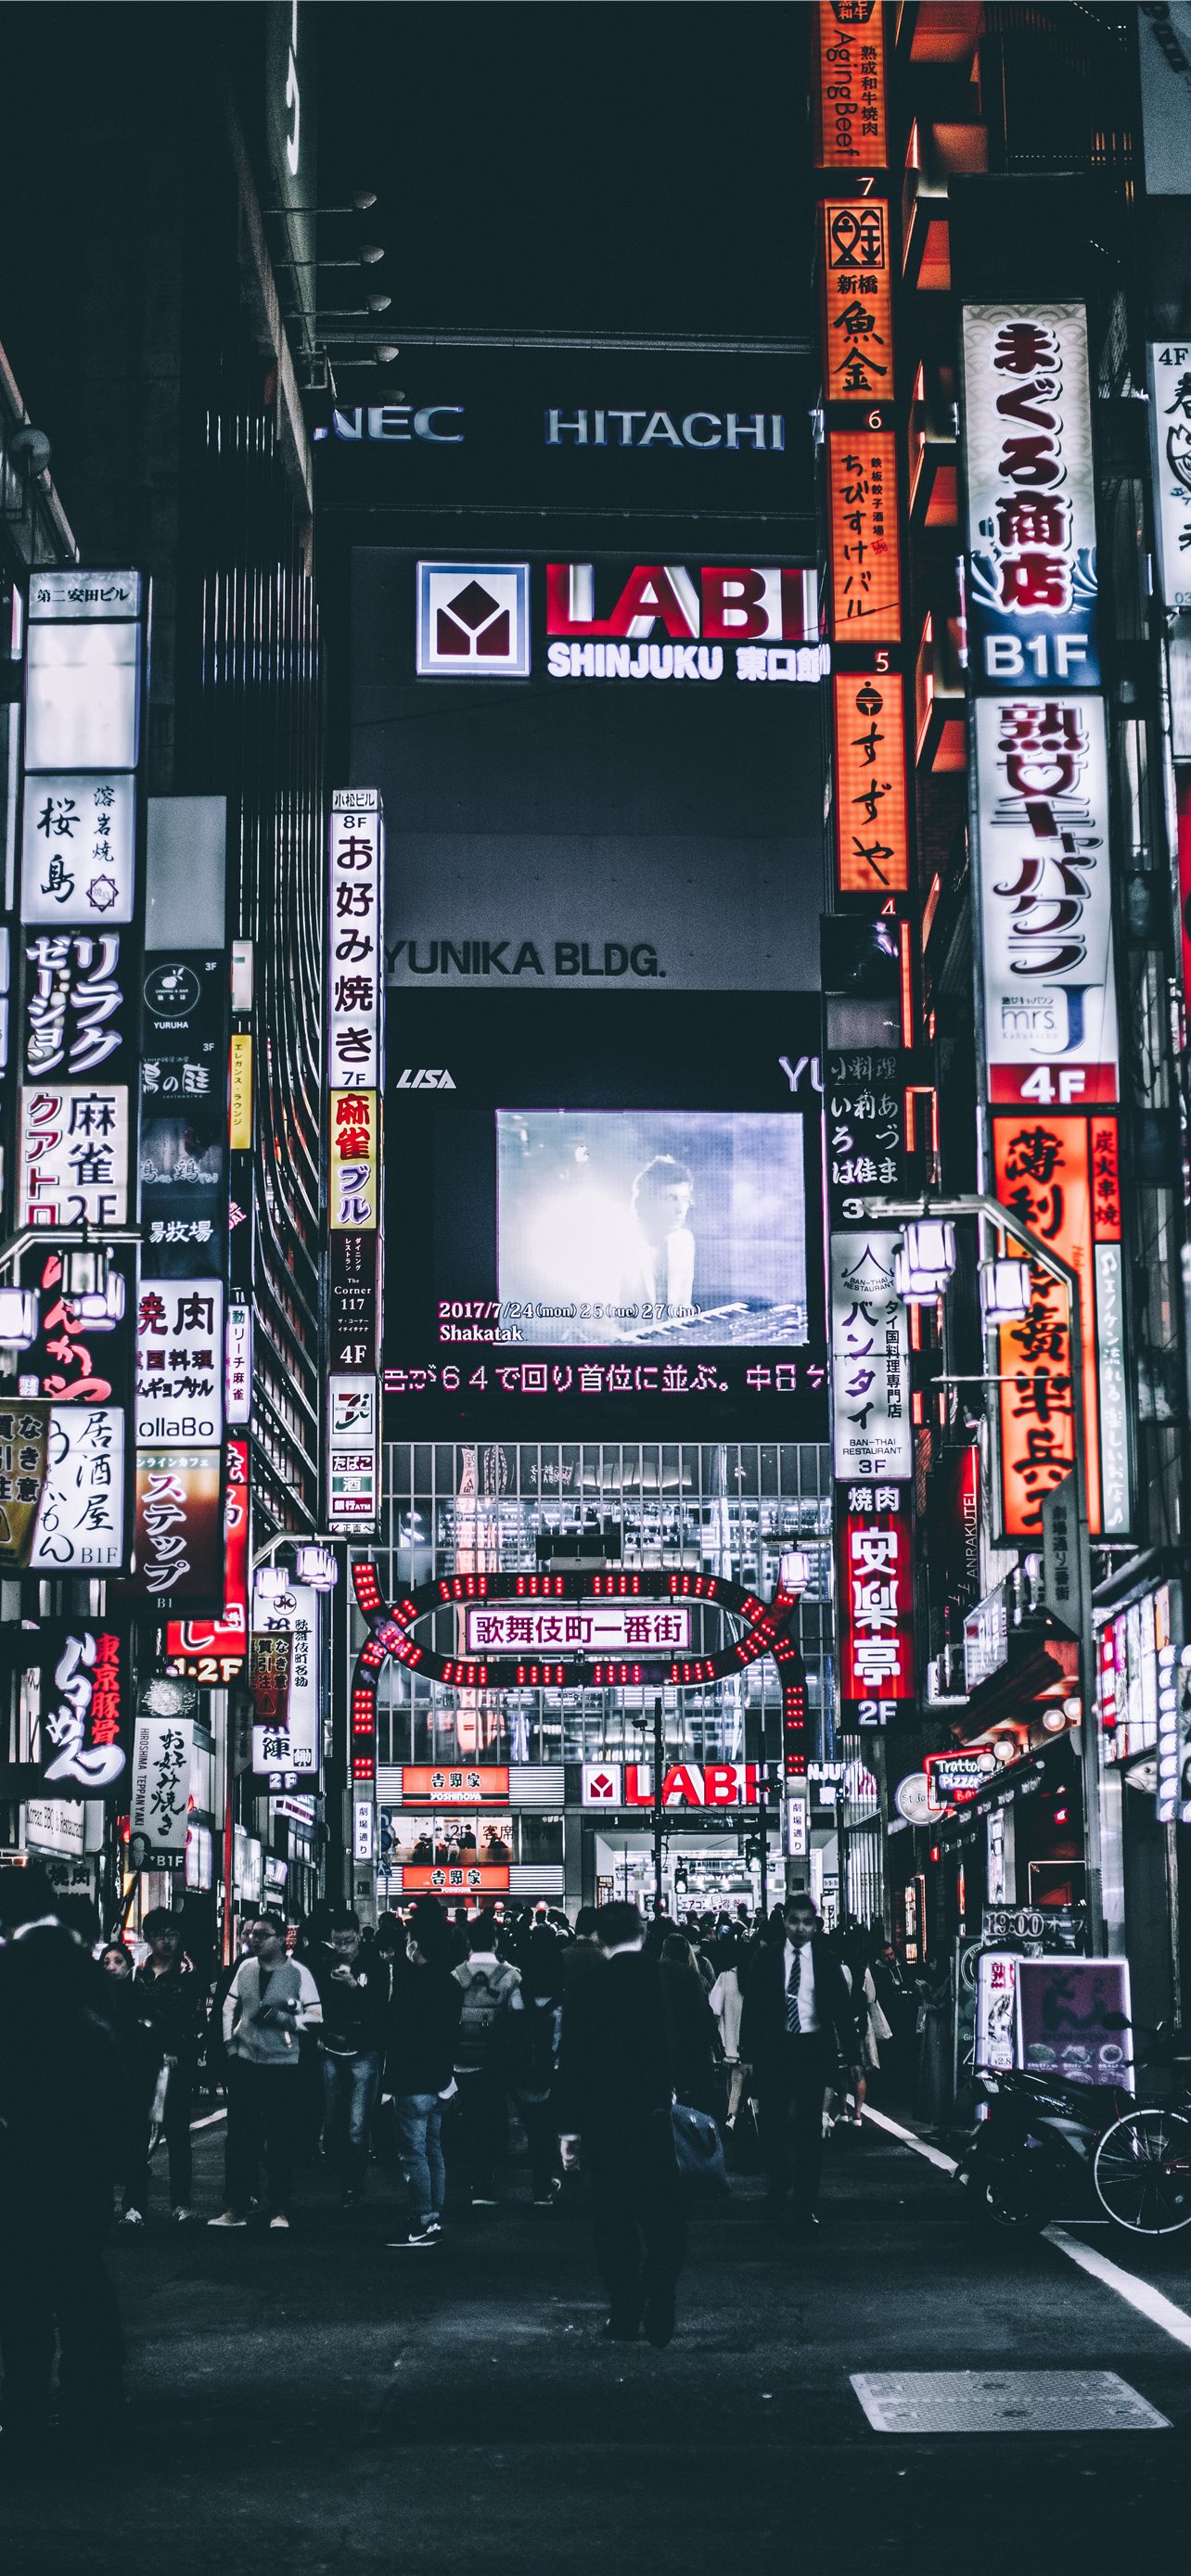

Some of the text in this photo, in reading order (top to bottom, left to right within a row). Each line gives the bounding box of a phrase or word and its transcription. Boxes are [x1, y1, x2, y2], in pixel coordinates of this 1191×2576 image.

[861, 45, 878, 136] 熟成和牛焼肉
[859, 177, 875, 196] 7
[837, 274, 878, 295] 新橋
[832, 300, 889, 391] 魚金
[1159, 348, 1189, 365] 4F
[314, 405, 464, 441] NEC
[544, 408, 786, 451] HITACHI
[868, 410, 882, 428] 6
[992, 321, 1072, 613] まぐろ商店
[870, 457, 885, 536] 鉄板餃子酒場
[839, 454, 877, 618] ちびすけバル
[37, 586, 131, 604] 第二安田ビル
[545, 563, 820, 643] LABI
[546, 642, 724, 682] SHINJUKU
[876, 653, 890, 673] 5
[986, 635, 1088, 677] B1F
[335, 793, 376, 807] 小松ビル
[850, 722, 895, 886] すずや
[92, 785, 116, 861] 溶岩焼
[343, 815, 367, 829] 8F
[37, 797, 81, 903] 桜島
[990, 703, 1104, 978] 熟女キャバクラ
[881, 898, 896, 915] 4
[335, 835, 374, 1064] お好み焼き
[385, 940, 667, 978] YUNIKA BLDG.
[205, 962, 217, 971] 3F
[154, 1021, 188, 1029] YURUHA
[202, 1043, 215, 1052] 3F
[342, 1071, 366, 1085] 7F
[396, 1069, 456, 1090] LISA
[831, 1055, 897, 1081] 小料理
[1020, 1065, 1086, 1103] 4F
[66, 1093, 117, 1188] 麻雀
[334, 1286, 371, 1294] Corner
[843, 1281, 895, 1293] RESTAURANT
[340, 1299, 365, 1310] 117
[439, 1324, 524, 1342] Shakatak
[233, 1328, 246, 1401] リーチ麻雀
[340, 1345, 367, 1364] 4F
[841, 1300, 879, 1430] バンタイ
[885, 1300, 903, 1419] タイ国料理専門店
[137, 1417, 214, 1437] ollaBo
[842, 1447, 903, 1456] RESTAURANT
[850, 1438, 896, 1447] BAN-THAI
[73, 1411, 113, 1531] 居酒屋
[334, 1457, 372, 1471] たばこ
[859, 1460, 887, 1474] 3F
[342, 1477, 362, 1492] 酒
[335, 1499, 371, 1511] 銀行ATM
[848, 1486, 900, 1512] 焼肉
[142, 1473, 191, 1593] ステップ
[81, 1547, 118, 1563] B1F
[157, 1598, 173, 1608] B1
[852, 1526, 901, 1687] 安楽亭
[476, 1615, 683, 1644] 歌舞伎町一番街
[294, 1619, 313, 1687] 歌舞伎町名物
[91, 1633, 121, 1745] 東京豚骨
[858, 1701, 897, 1725] 2F
[137, 1728, 149, 1770] HIROSHIMA
[150, 1728, 187, 1836] お好み焼き
[269, 1773, 298, 1791] 2F
[430, 1772, 481, 1789] 吉野家
[625, 1764, 768, 1806] LABI
[358, 1807, 368, 1855] 劇場通り
[793, 1804, 802, 1851] 劇場通り
[157, 1855, 184, 1867] B1F
[430, 1869, 481, 1886] 吉野家
[986, 1912, 1044, 1937] 19:00
